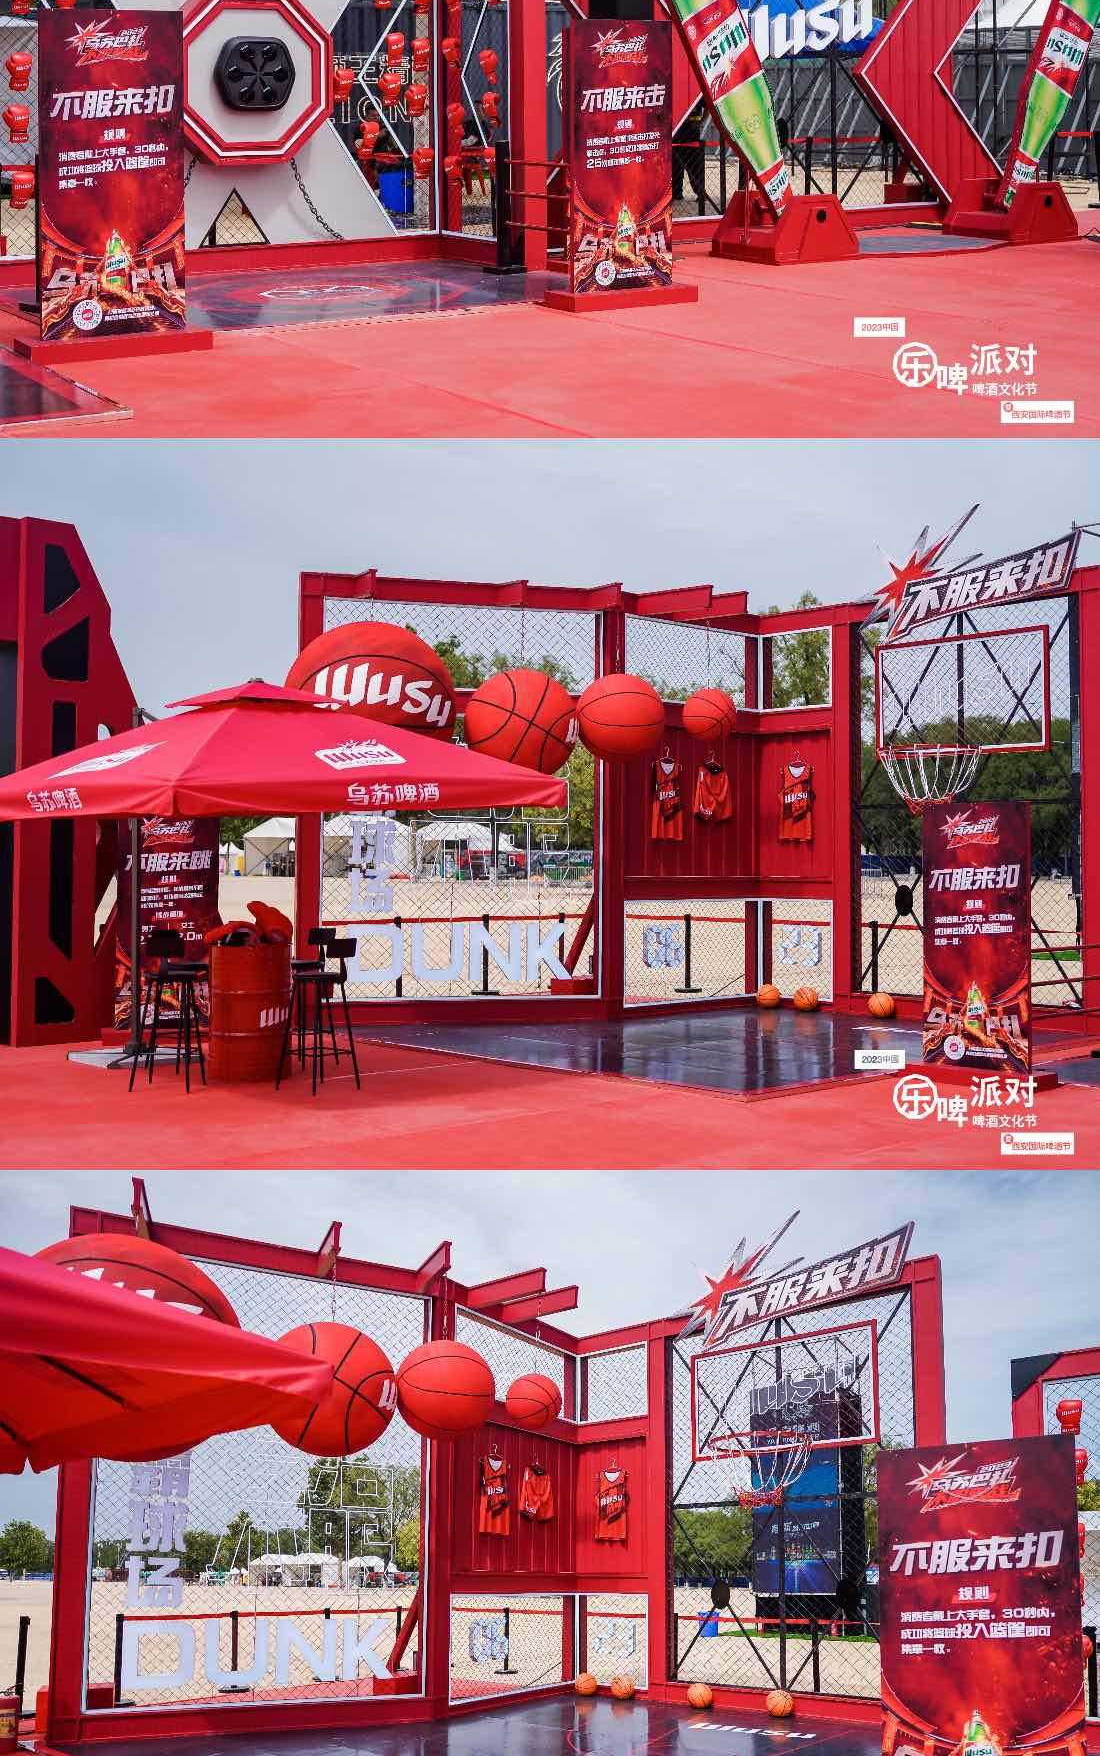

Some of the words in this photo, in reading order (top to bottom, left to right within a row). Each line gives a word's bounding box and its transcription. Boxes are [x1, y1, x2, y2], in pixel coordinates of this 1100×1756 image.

[50, 85, 175, 121] 不服来扣
[580, 84, 666, 113] 不服来击
[104, 128, 125, 141] 规则
[899, 540, 1071, 634] 不服来扣
[26, 787, 84, 813] 乌苏啤酒
[346, 782, 440, 806] 乌苏啤酒
[928, 864, 1021, 892] 不服来扣
[347, 923, 572, 982] DUNK
[715, 1234, 902, 1343] 不服来扣
[889, 1530, 1065, 1576] 不服来扣
[958, 1586, 989, 1601] 规则
[120, 1617, 395, 1691] DUNK
